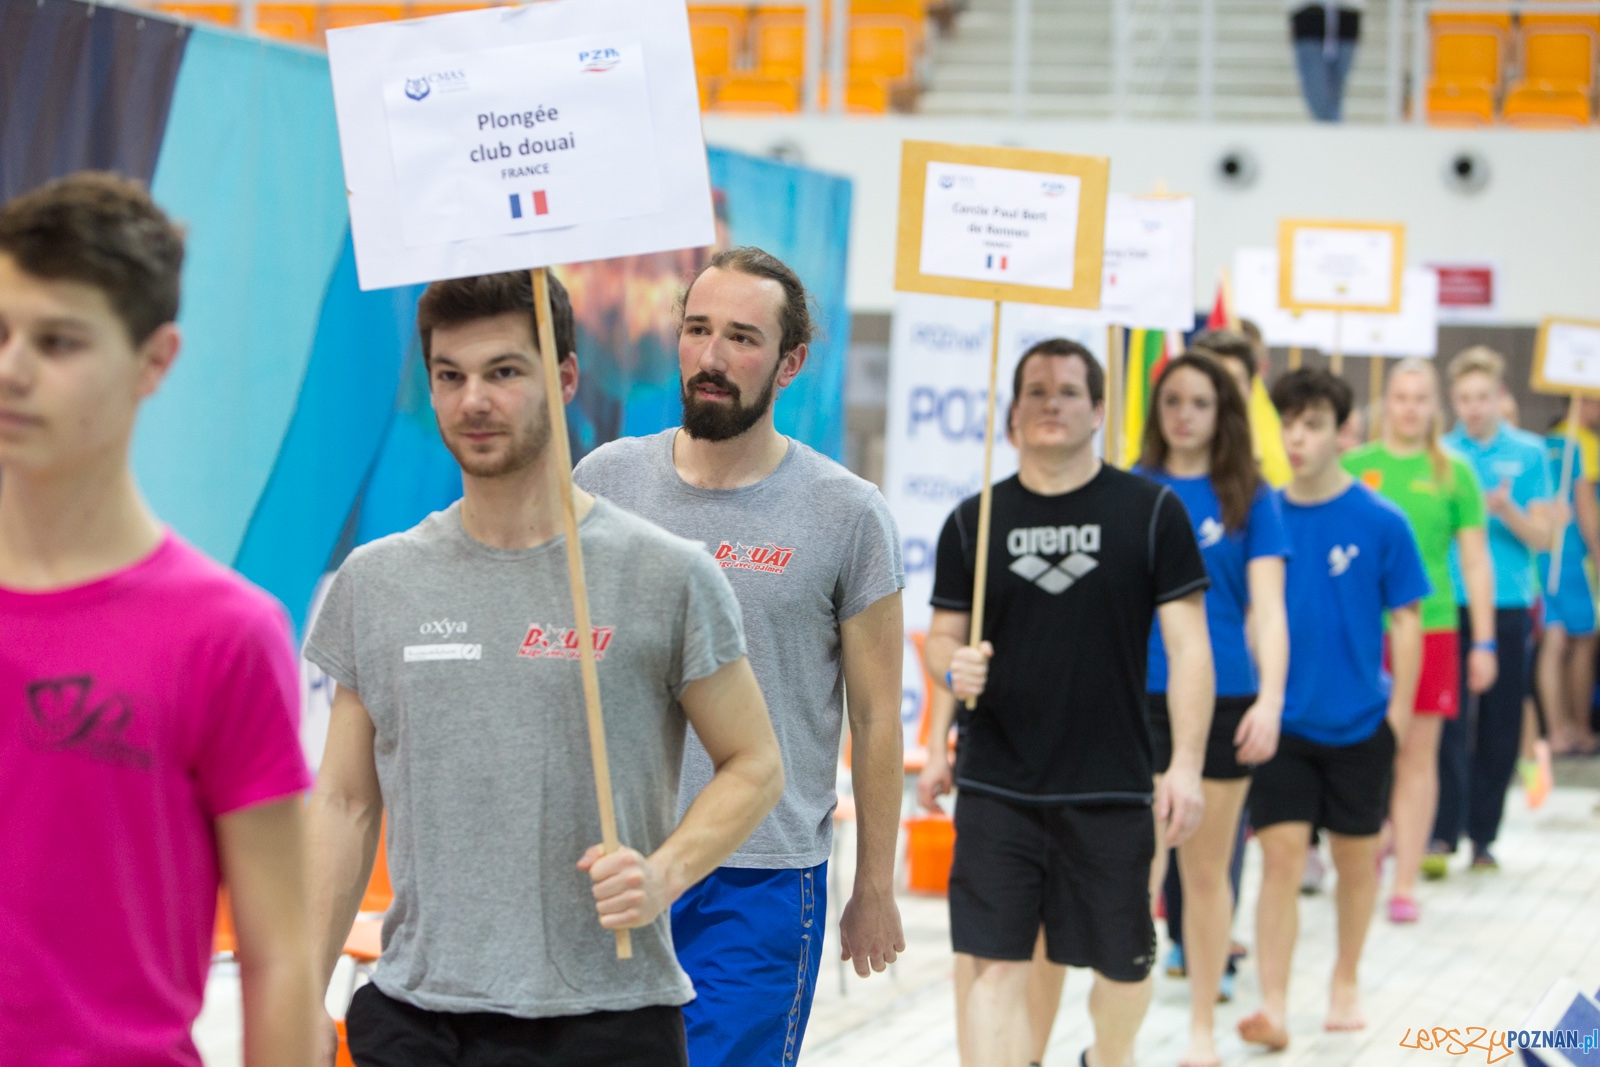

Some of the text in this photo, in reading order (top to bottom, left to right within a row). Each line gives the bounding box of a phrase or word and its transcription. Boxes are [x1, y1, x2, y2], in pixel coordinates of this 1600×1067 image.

[477, 104, 559, 131] Plongée
[469, 131, 575, 163] club douai
[501, 162, 550, 180] FRANCE
[1006, 523, 1101, 556] arena
[753, 563, 784, 575] palmes
